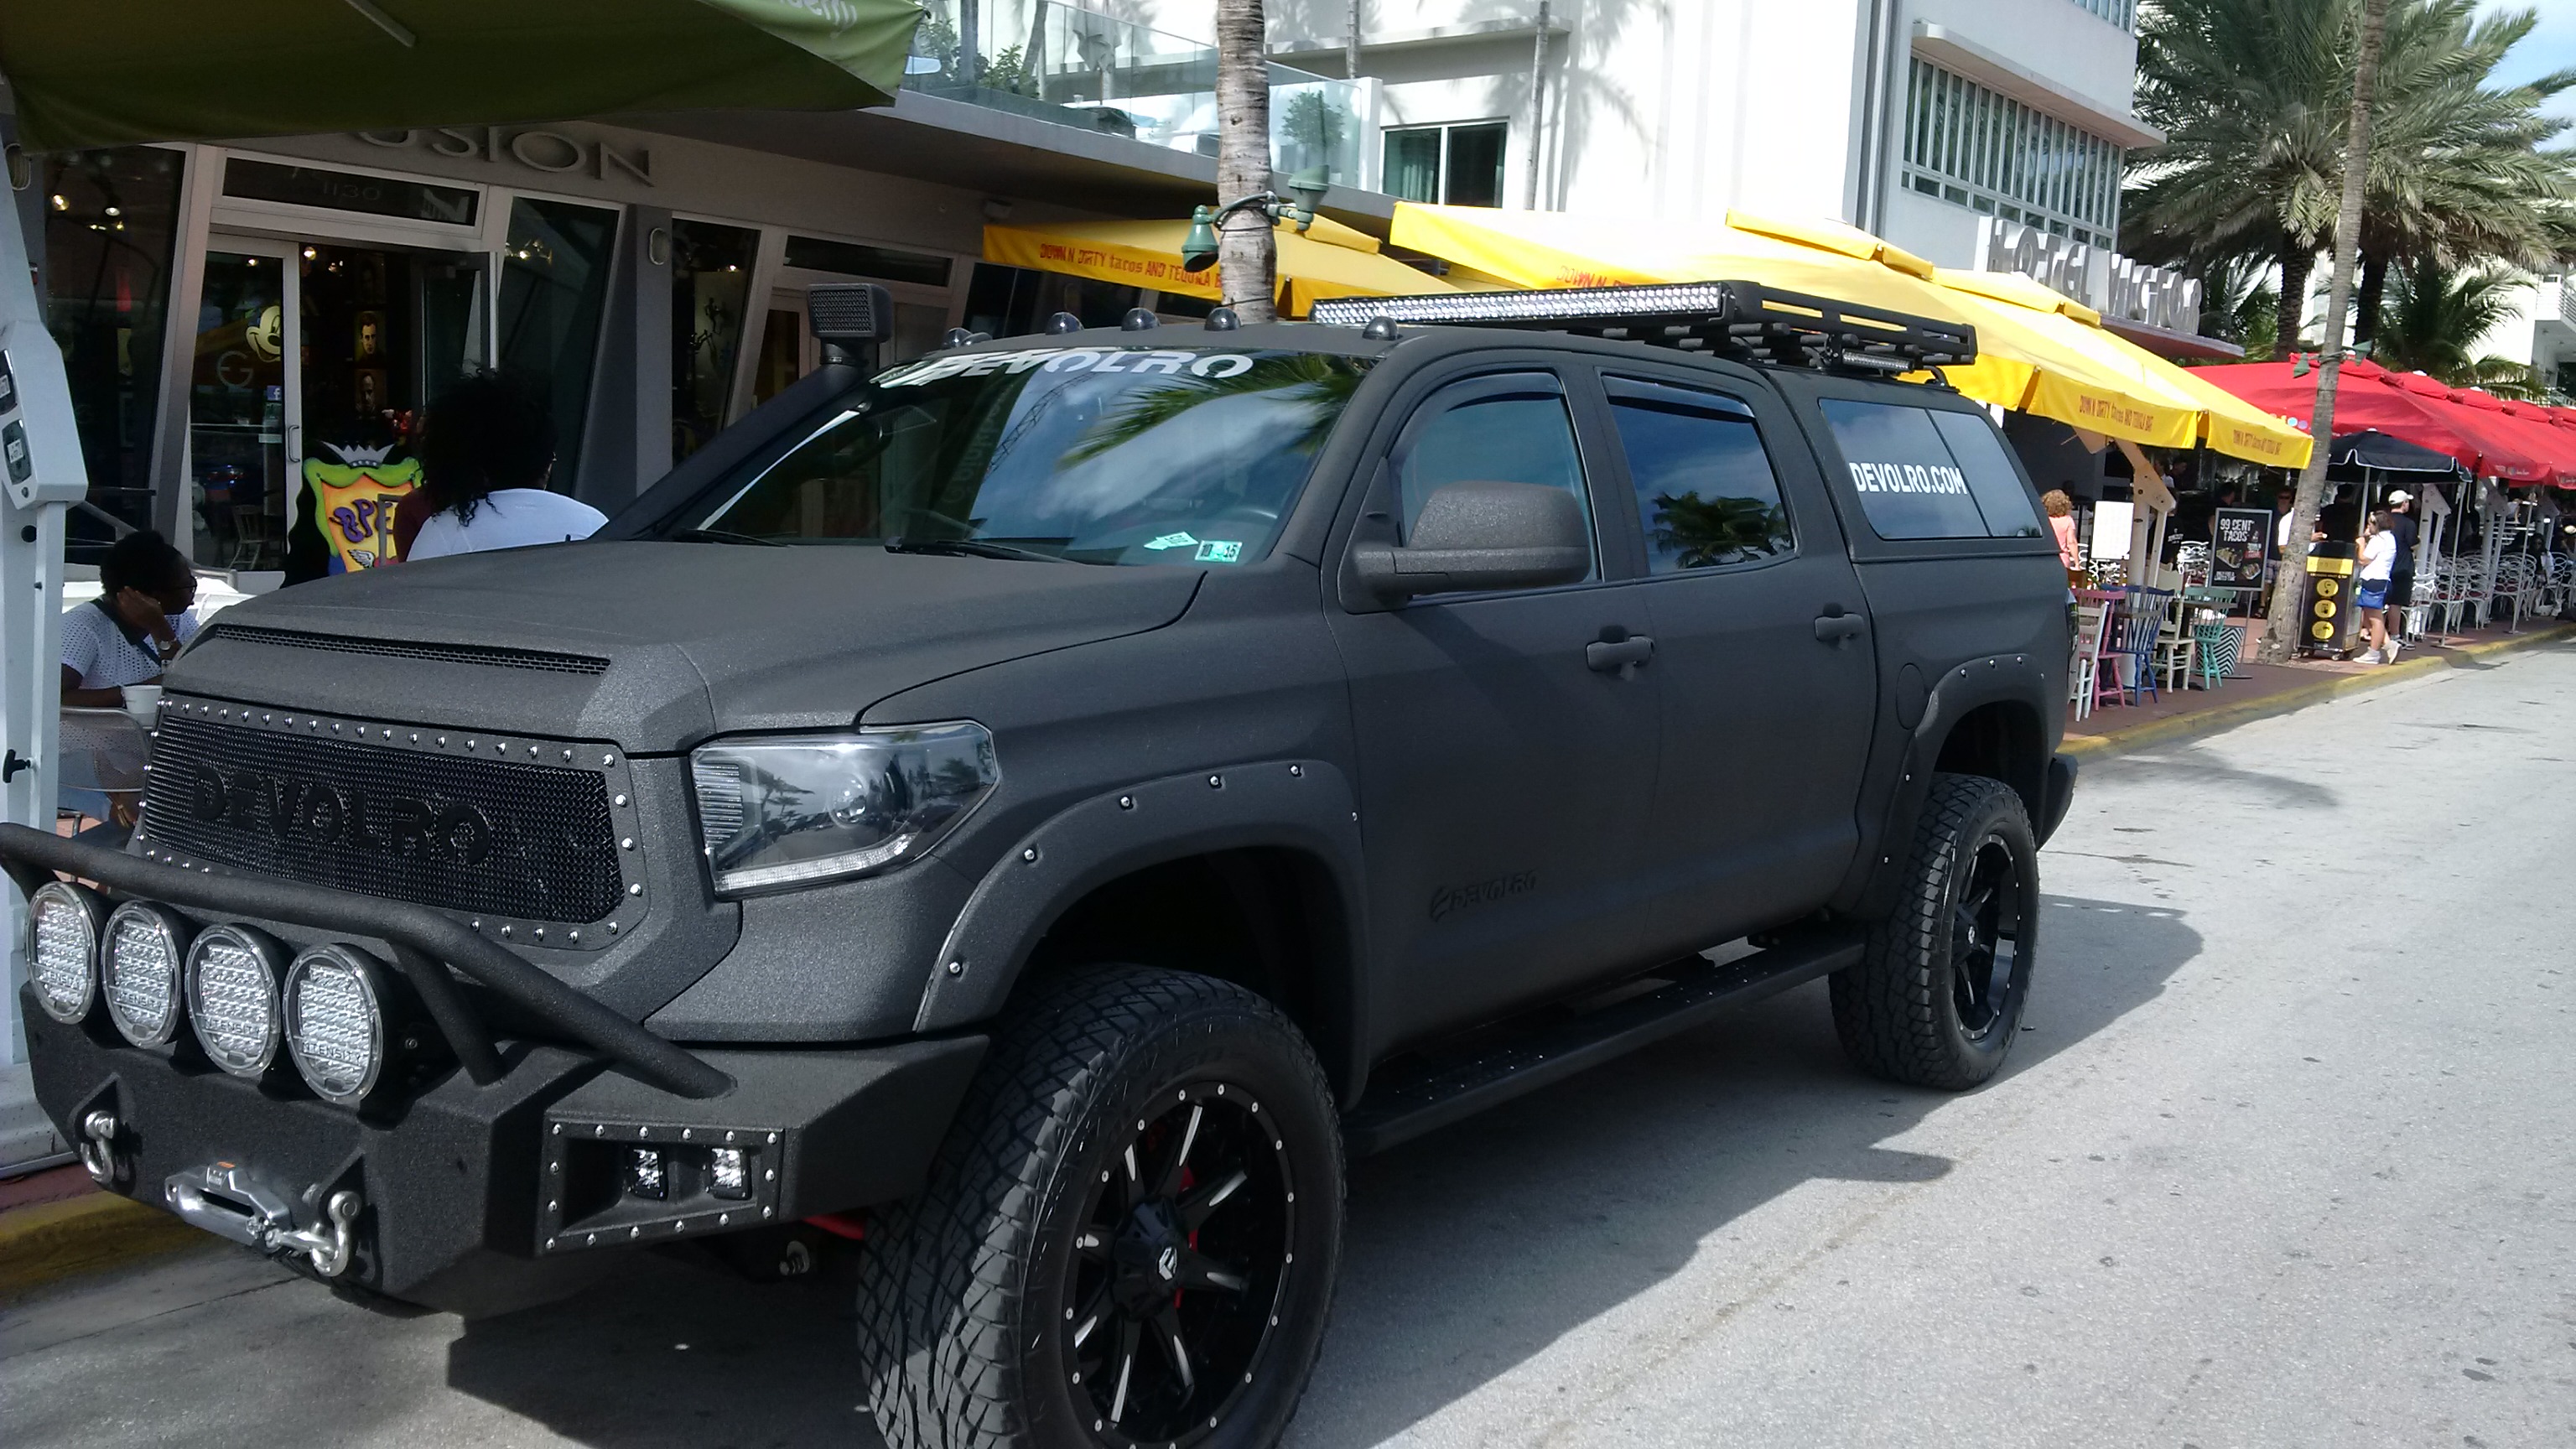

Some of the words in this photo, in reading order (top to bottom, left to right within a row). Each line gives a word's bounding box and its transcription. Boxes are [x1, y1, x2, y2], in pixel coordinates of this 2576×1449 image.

[1078, 248, 1106, 267] DIRTY
[1109, 254, 1143, 273] tacos
[1145, 260, 1166, 278] AND
[1849, 462, 1967, 495] DEVOLRO.COM
[333, 498, 394, 543] OPE
[2220, 518, 2231, 530] 99
[2231, 519, 2254, 532] CENT
[2224, 530, 2247, 543] TACOS
[191, 764, 491, 866] DEVOLRO
